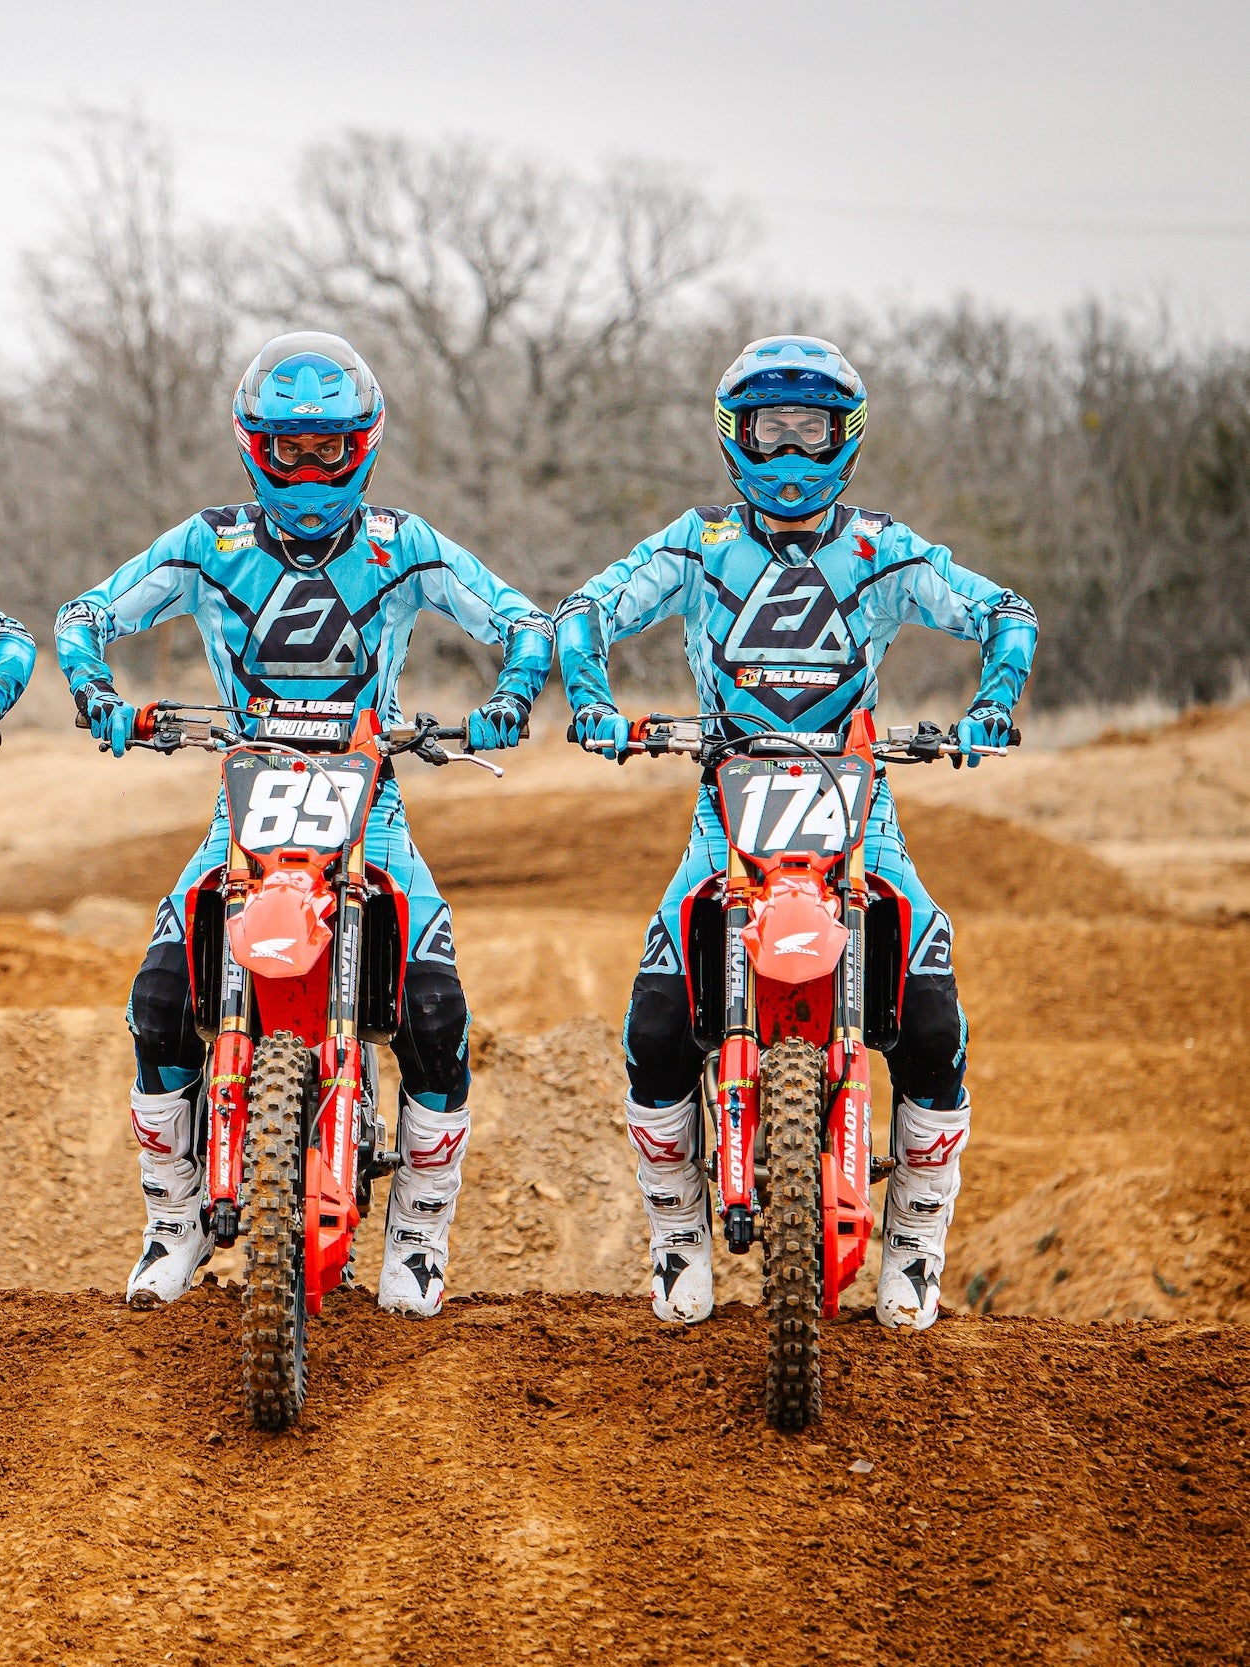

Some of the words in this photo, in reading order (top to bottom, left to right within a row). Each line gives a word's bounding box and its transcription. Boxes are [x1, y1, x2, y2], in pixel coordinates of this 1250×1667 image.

[269, 720, 337, 738] PROTAPER
[777, 761, 822, 769] MONSTE
[239, 770, 365, 851] 89
[736, 774, 862, 854] 174
[250, 952, 294, 965] HONDA
[774, 947, 821, 957] HONDA
[211, 1074, 247, 1086] TAMER
